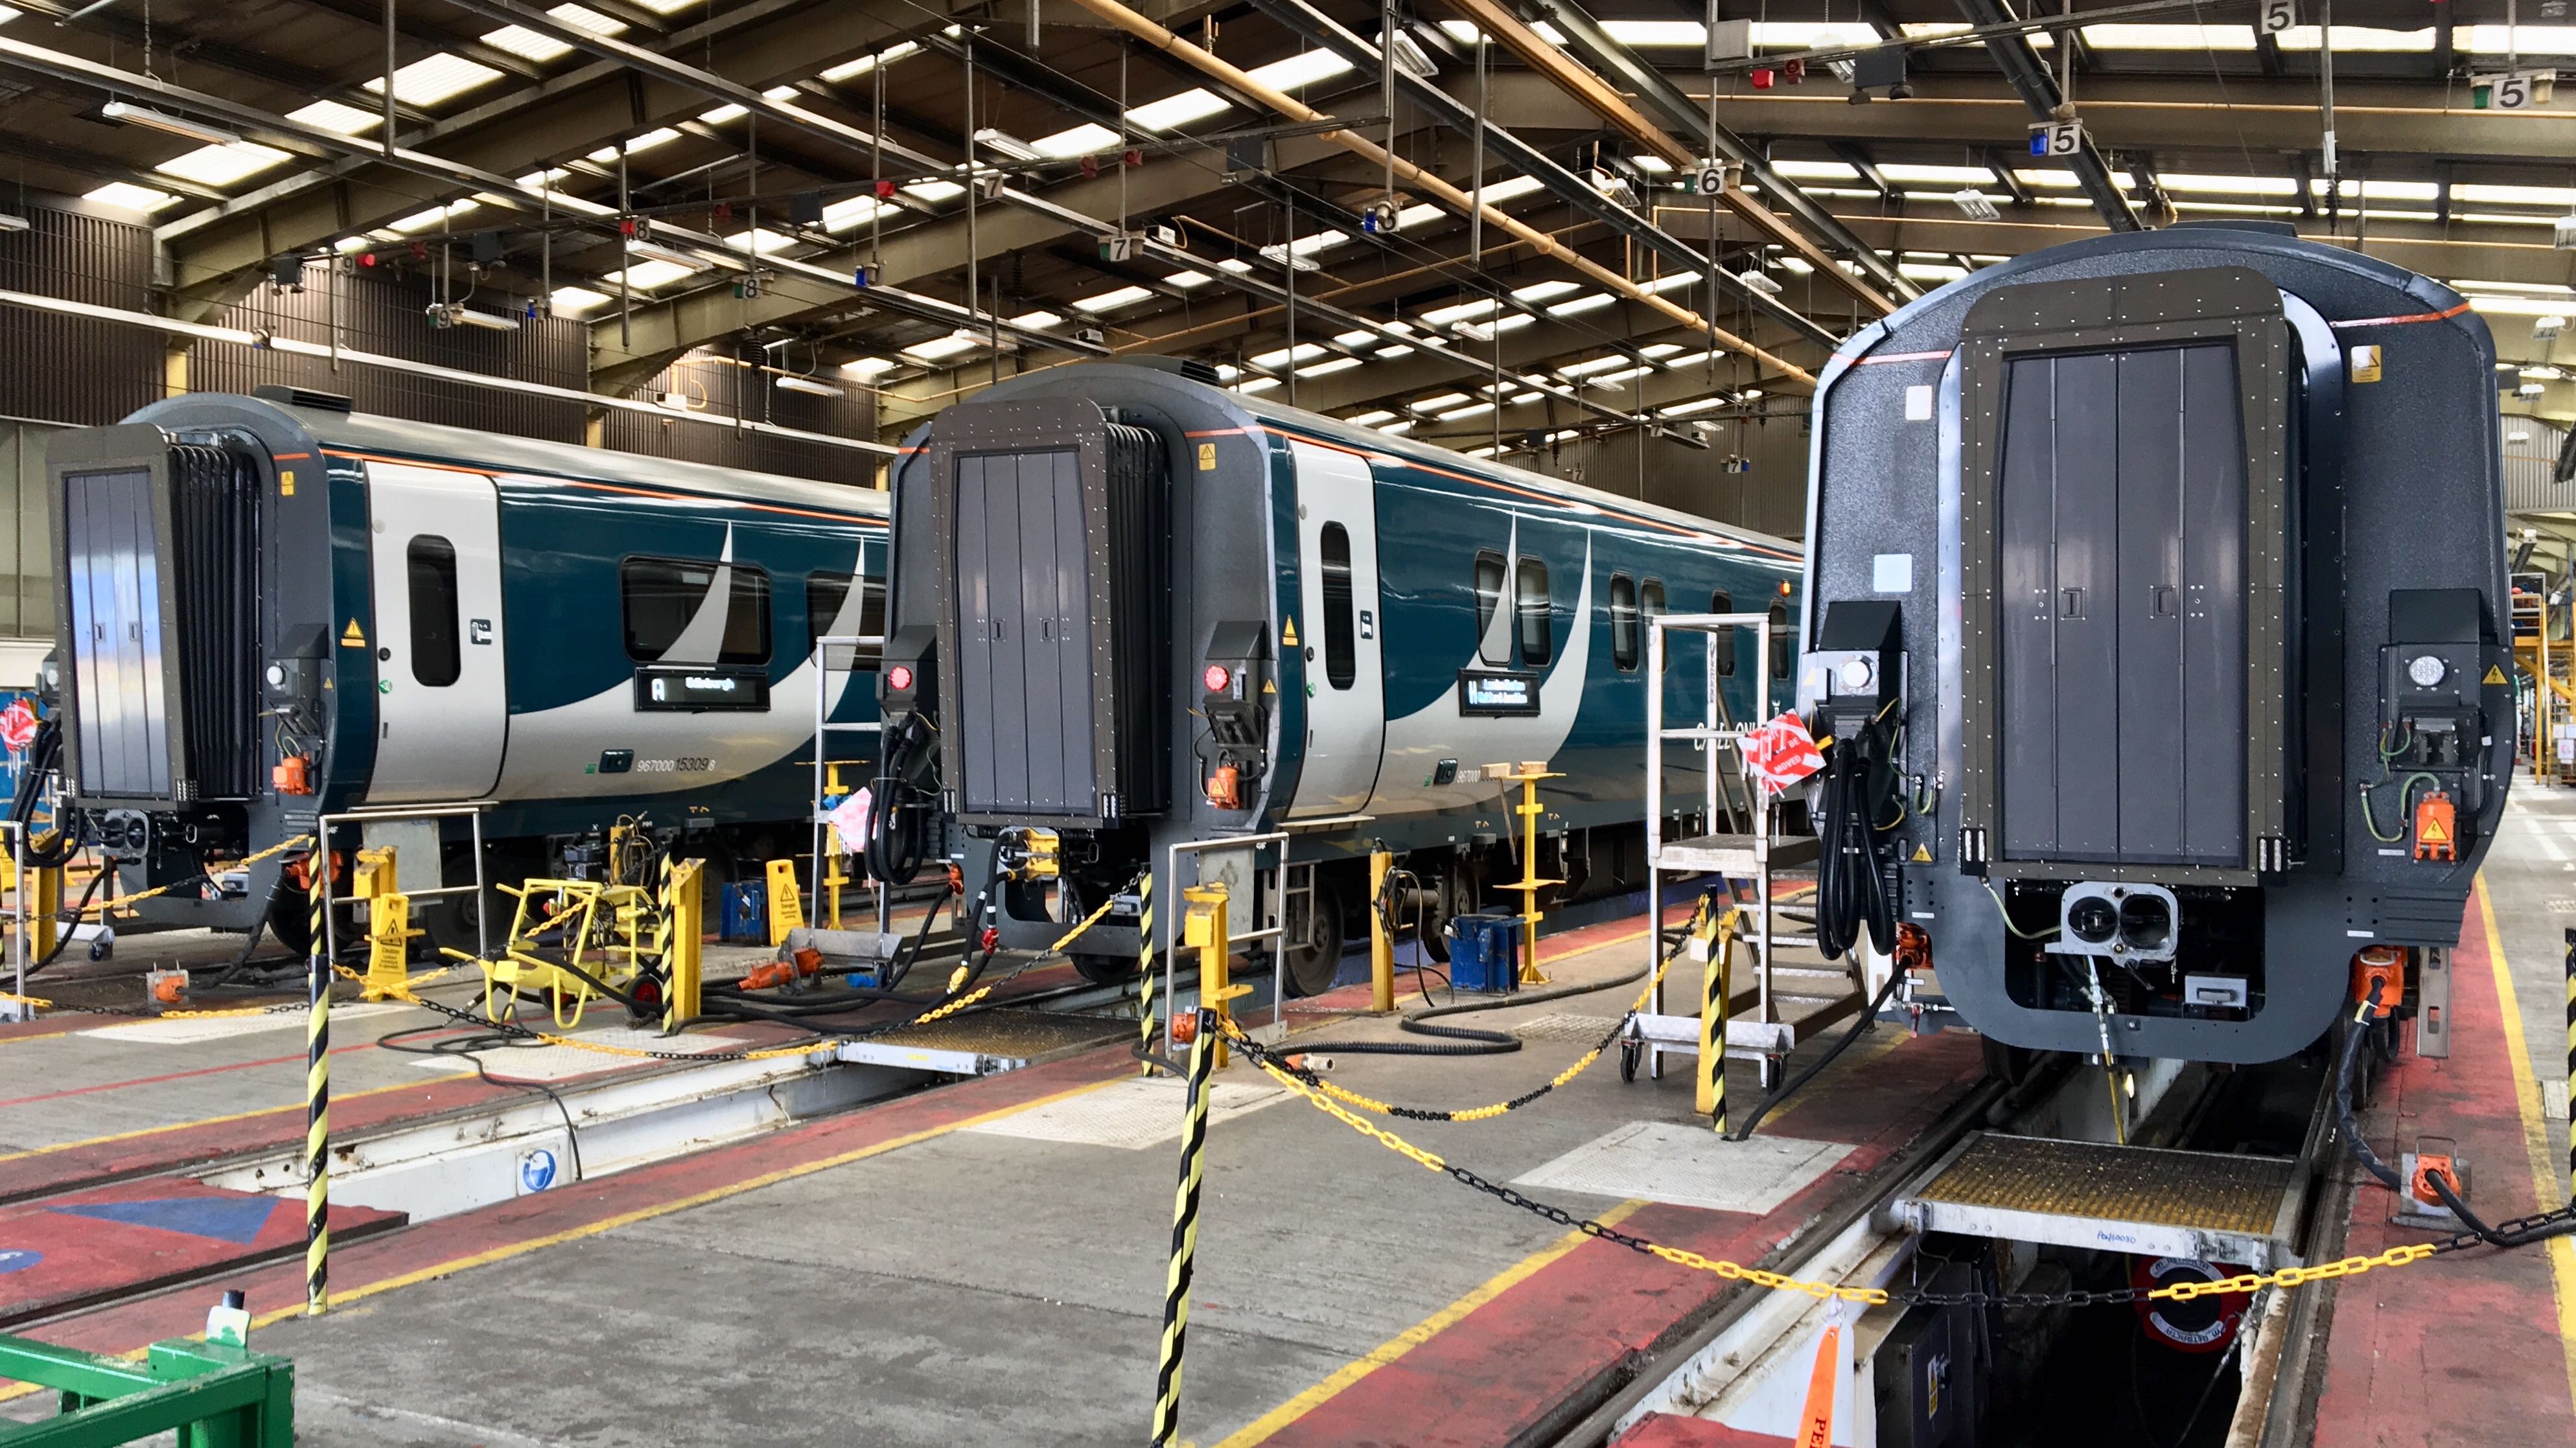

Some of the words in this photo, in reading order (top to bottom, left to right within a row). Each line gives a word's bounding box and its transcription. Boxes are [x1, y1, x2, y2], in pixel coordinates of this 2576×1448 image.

[2268, 2, 2290, 30] 5
[2500, 80, 2524, 108] 5
[2054, 126, 2074, 153] 5
[988, 176, 999, 197] 7
[1702, 168, 1720, 193] 6
[637, 220, 647, 239] 8
[1115, 239, 1126, 259] 7
[343, 257, 353, 273] 9
[746, 279, 757, 298] 8
[439, 309, 449, 327] 9
[1575, 470, 1582, 481] 7
[1731, 461, 1739, 472] 7
[652, 678, 665, 701] A
[1774, 754, 1802, 774] MOVED
[1809, 1417, 1828, 1448] PE
